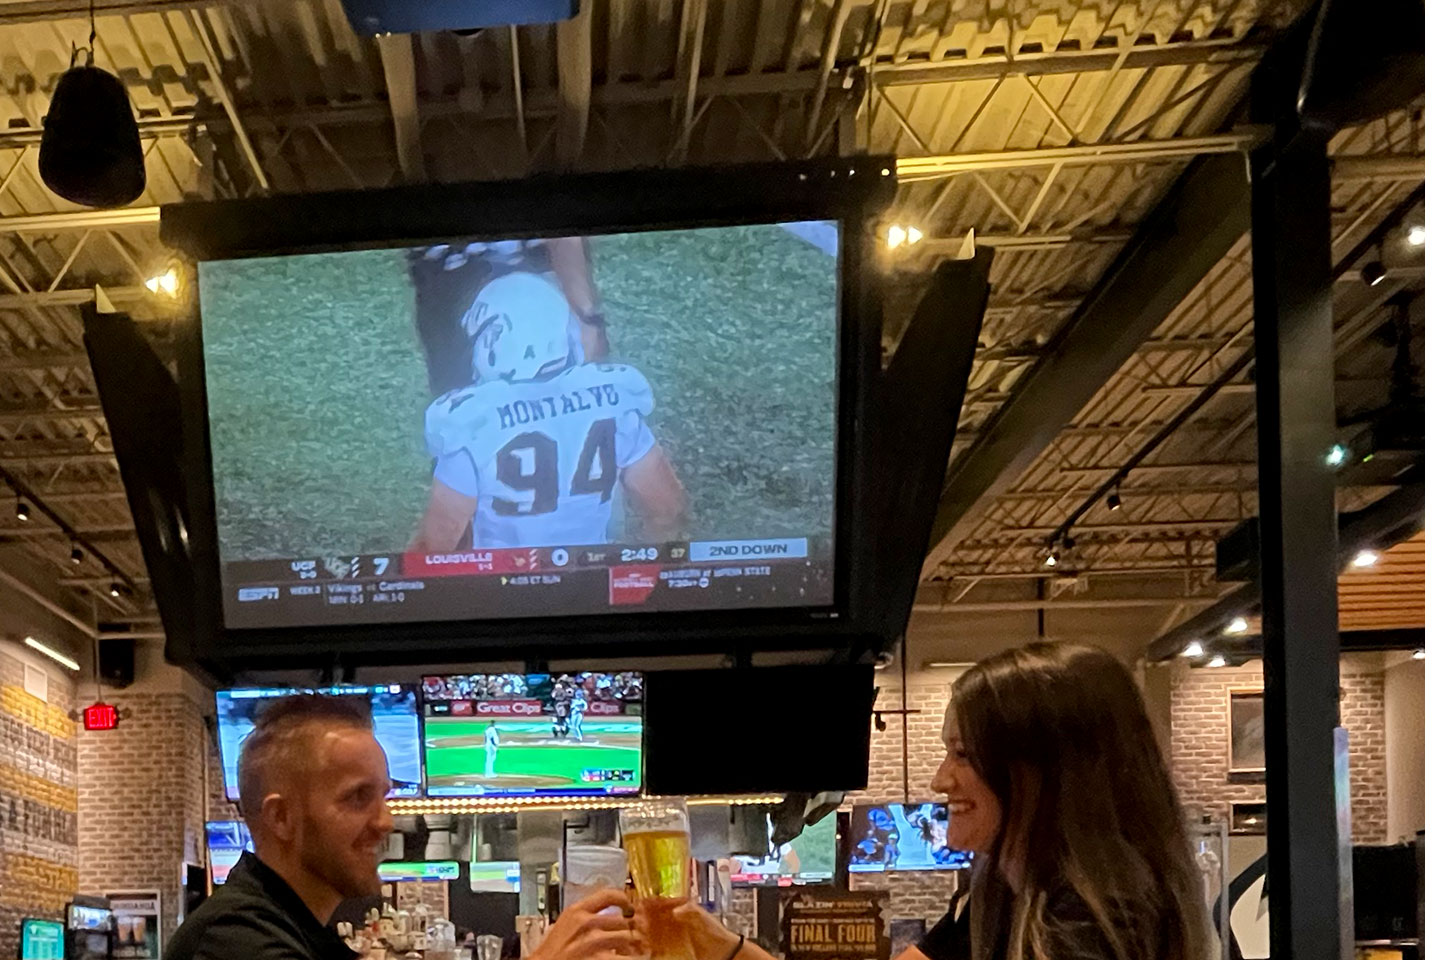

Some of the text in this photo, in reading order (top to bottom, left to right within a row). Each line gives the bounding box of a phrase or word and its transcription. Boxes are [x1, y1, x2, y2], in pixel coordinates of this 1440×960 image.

[497, 383, 619, 429] MONTALVO
[491, 418, 617, 517] 94
[551, 548, 569, 566] 0
[621, 548, 658, 561] 2:49
[709, 544, 788, 556] 2ND DOWN
[425, 552, 493, 564] LOUISVILLE
[291, 560, 316, 571] UCF
[373, 557, 389, 575] 7
[238, 587, 279, 601] ESPN
[477, 702, 541, 715] Great Clips
[590, 702, 620, 714] Clips
[88, 707, 115, 728] EXIT
[790, 924, 876, 942] FINAL FOUR
